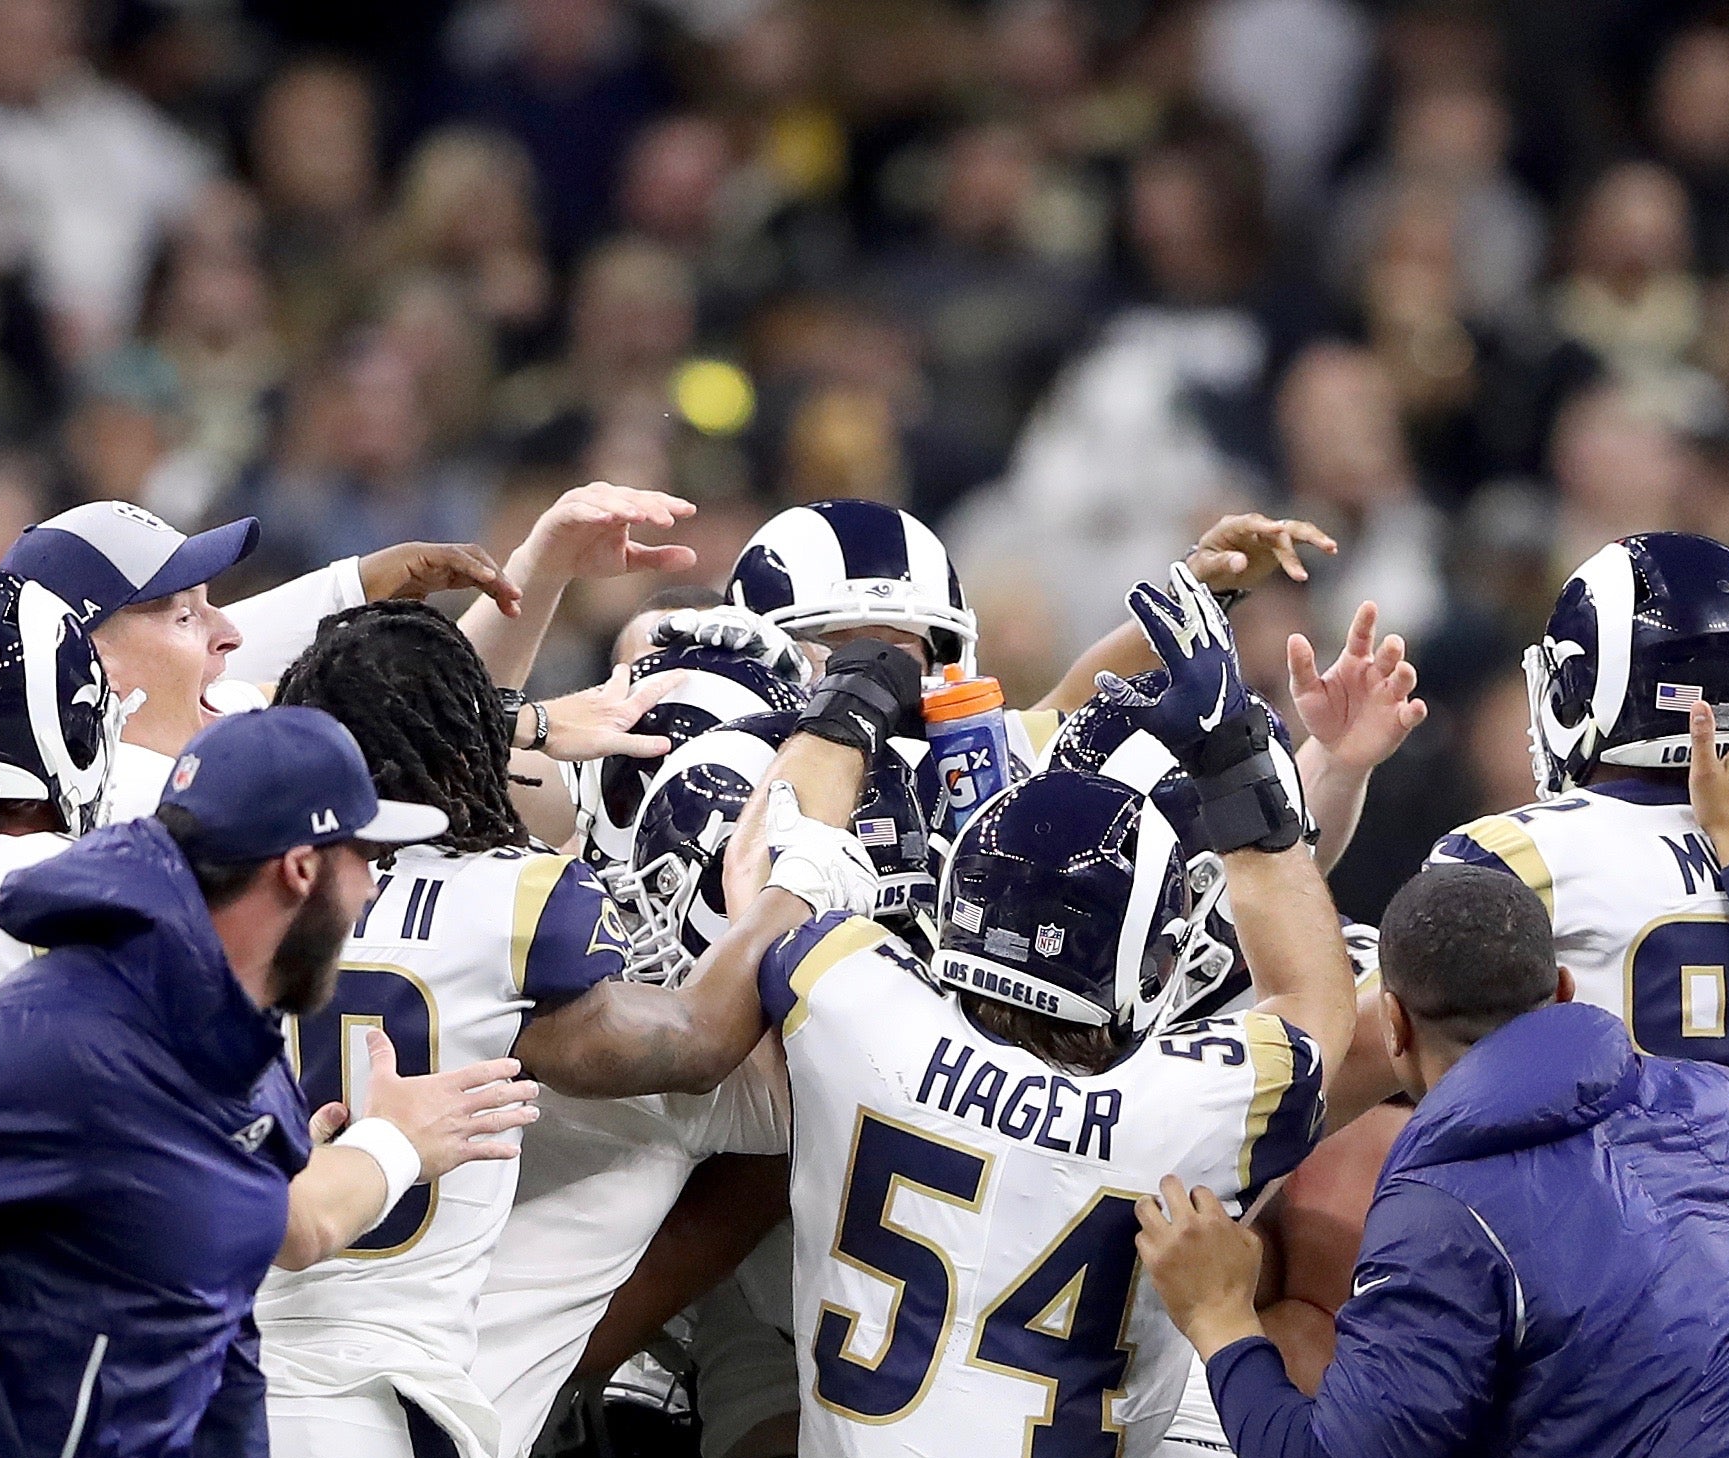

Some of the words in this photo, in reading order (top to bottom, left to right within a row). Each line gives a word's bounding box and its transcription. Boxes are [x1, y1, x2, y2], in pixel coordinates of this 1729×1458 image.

[1662, 745, 1692, 764] LO
[310, 808, 341, 835] LA
[943, 959, 967, 983] LOS
[972, 969, 1059, 1014] ANGELES
[915, 1036, 1122, 1162] HAGER
